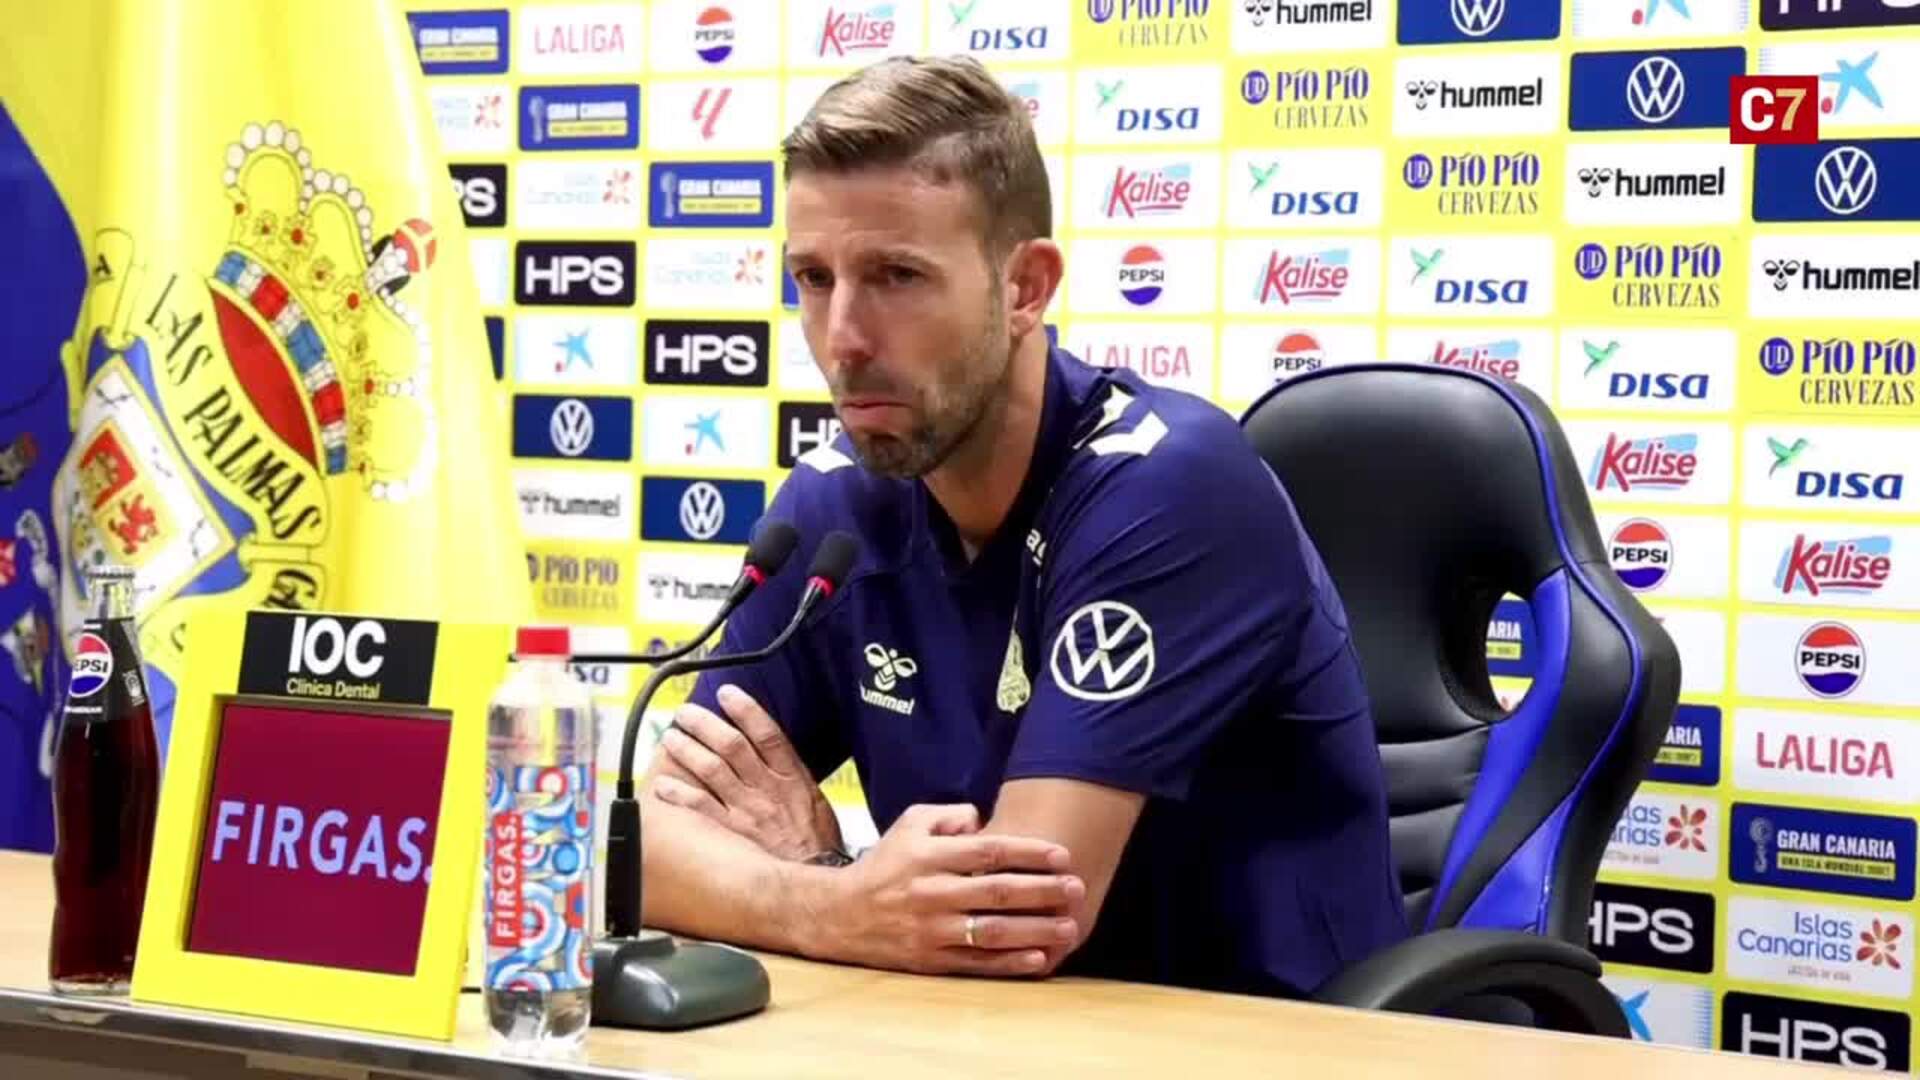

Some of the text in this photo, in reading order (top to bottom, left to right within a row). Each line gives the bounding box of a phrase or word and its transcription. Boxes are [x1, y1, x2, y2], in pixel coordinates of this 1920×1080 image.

[1276, 0, 1372, 24] hummel
[534, 24, 625, 54] LALIGA
[820, 7, 895, 57] Kalise
[1440, 77, 1543, 109] hummel
[1274, 104, 1368, 129] CERVEZAS
[1107, 166, 1190, 218] Kalise
[1614, 166, 1725, 197] hummel
[1438, 191, 1538, 215] CERVEZAS
[525, 256, 624, 295] HPS
[1119, 269, 1164, 282] PEPSI
[1260, 248, 1349, 305] Kalise
[1803, 260, 1920, 290] hummel
[1613, 283, 1720, 308] CERVEZAS
[655, 334, 757, 375] HPS
[146, 274, 213, 386] LAS
[183, 385, 322, 540] PALMAS
[1800, 378, 1915, 406] CERVEZAS
[1596, 432, 1698, 492] Kalise
[1612, 547, 1668, 565] PEPSI
[1782, 534, 1891, 596] Kalise
[1487, 621, 1521, 640] ARIA
[289, 616, 387, 678] IOC
[1800, 651, 1860, 669] PEPSI
[334, 680, 380, 699] Dental
[1665, 725, 1702, 746] ARIA
[1756, 731, 1894, 779] LALIGA
[1777, 829, 1896, 860] GRAN CANARIA
[1794, 911, 1853, 940] Islas
[1738, 928, 1852, 963] Canarias
[1741, 1013, 1888, 1071] HPS
